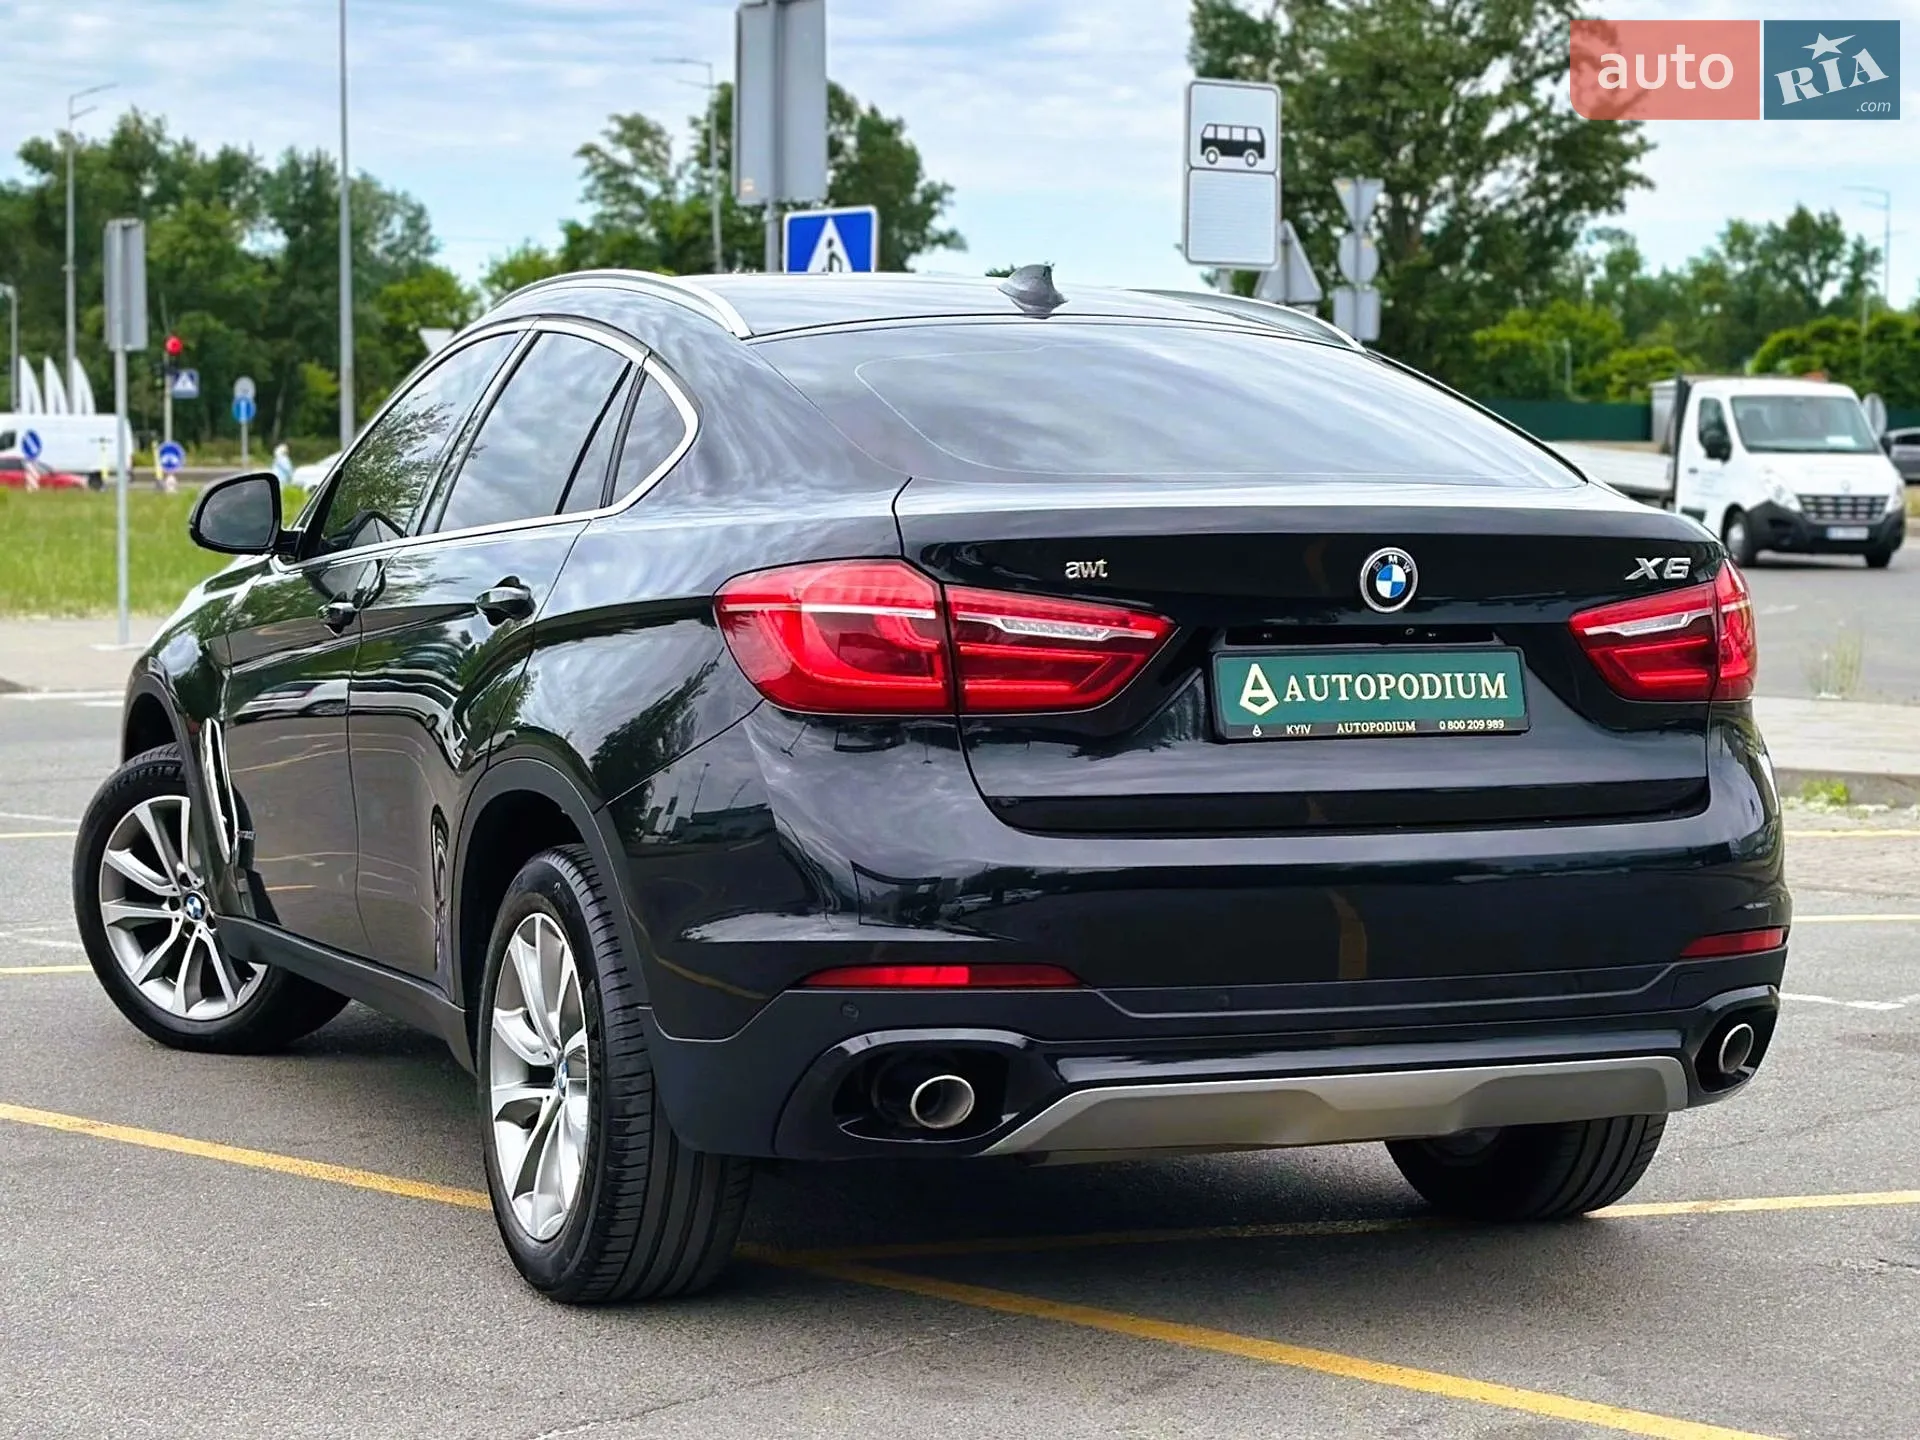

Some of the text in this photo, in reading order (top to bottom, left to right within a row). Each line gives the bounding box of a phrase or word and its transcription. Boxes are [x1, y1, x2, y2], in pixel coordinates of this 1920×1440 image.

[1065, 559, 1108, 579] awt
[1372, 555, 1412, 573] BMW
[1625, 557, 1691, 581] X6
[1284, 673, 1508, 702] AUTOPODIUM
[1286, 724, 1312, 735] KYIV
[1337, 721, 1416, 734] AUTOPODIUM
[1439, 719, 1505, 730] 0 800 209 989
